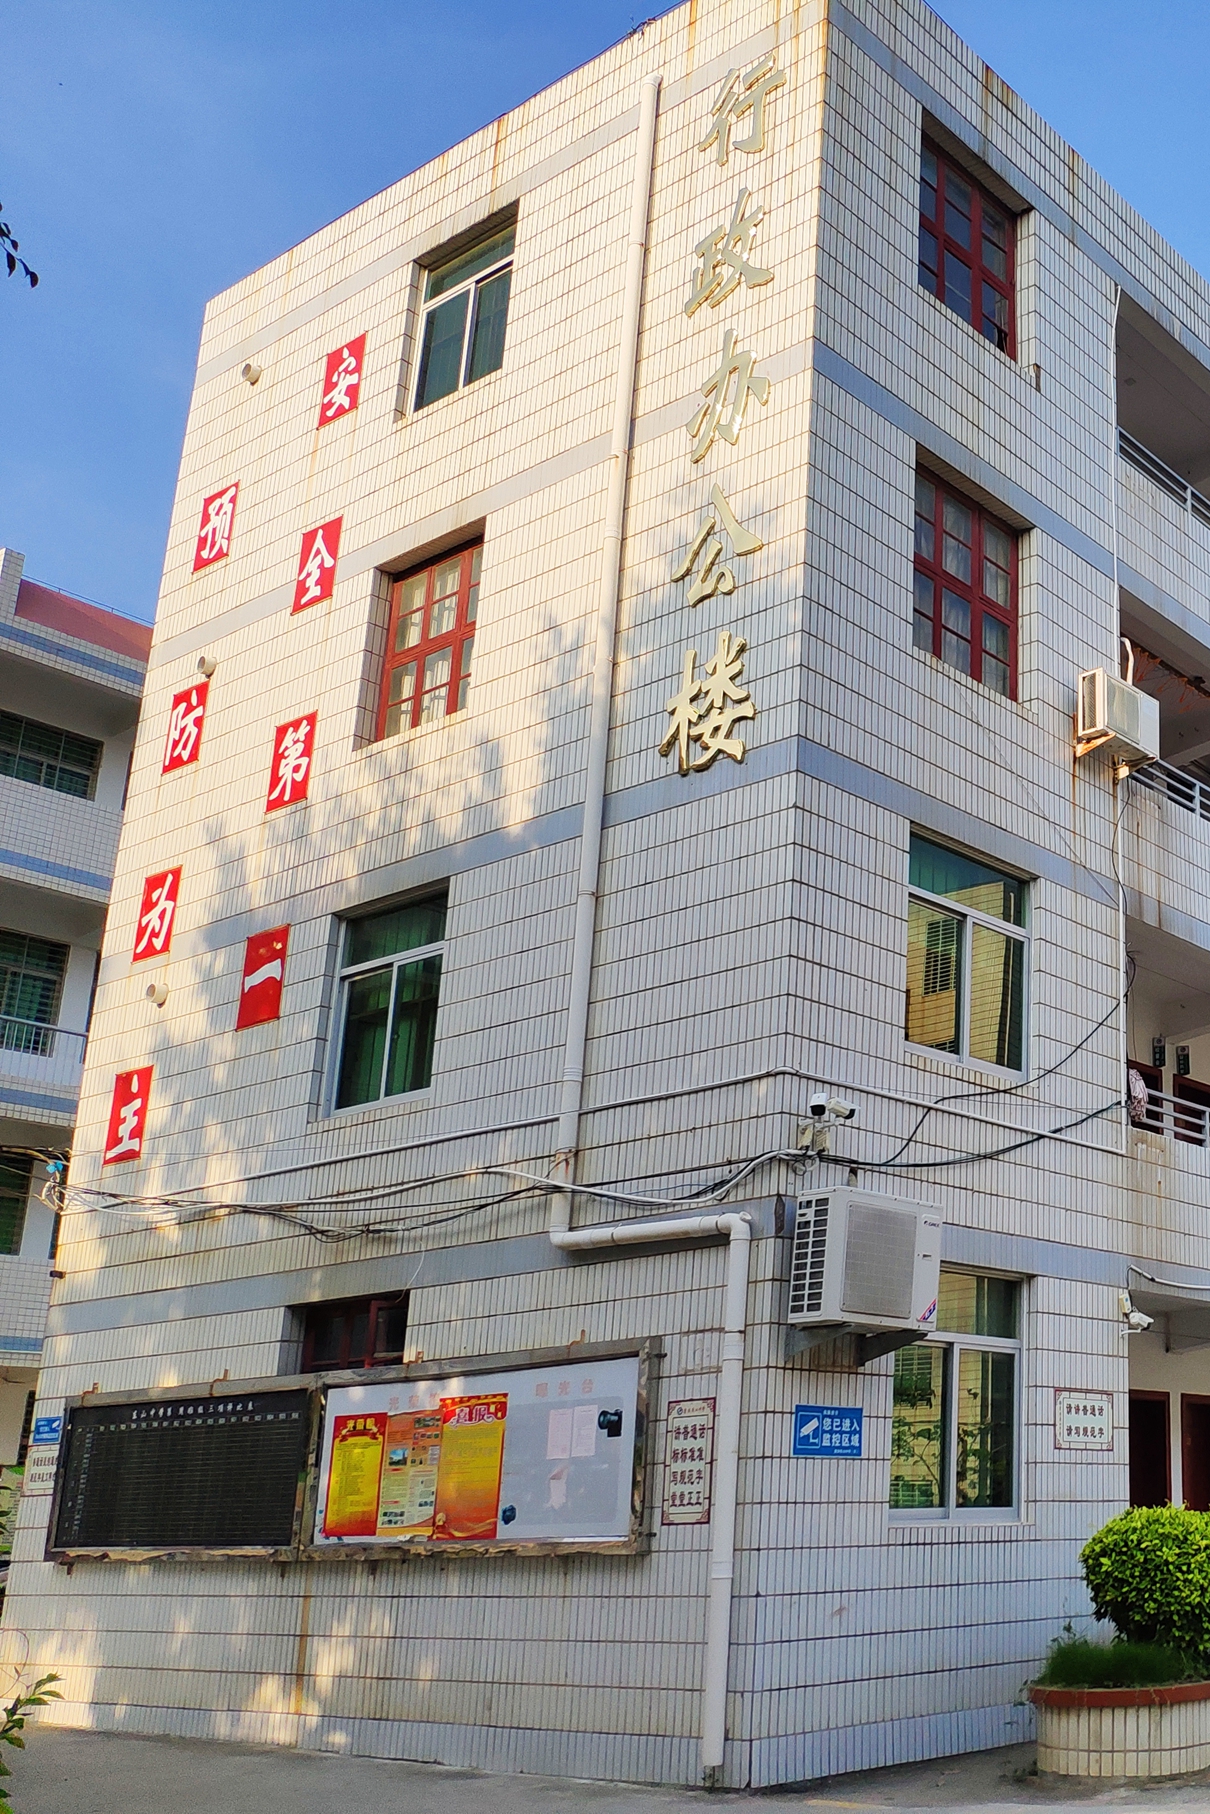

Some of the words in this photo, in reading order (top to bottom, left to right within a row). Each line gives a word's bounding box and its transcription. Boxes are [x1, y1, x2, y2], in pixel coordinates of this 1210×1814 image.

[657, 53, 786, 776] 行政办公楼
[244, 347, 359, 993] 安全第一
[105, 486, 237, 1160] 预防为主
[674, 1424, 706, 1440] 讲普通话
[823, 1418, 860, 1431] 您已进入
[822, 1433, 860, 1447] 监控区域
[671, 1447, 704, 1463] 标标准准
[670, 1468, 704, 1486] 写规范字
[670, 1491, 702, 1507] 堂堂正正
